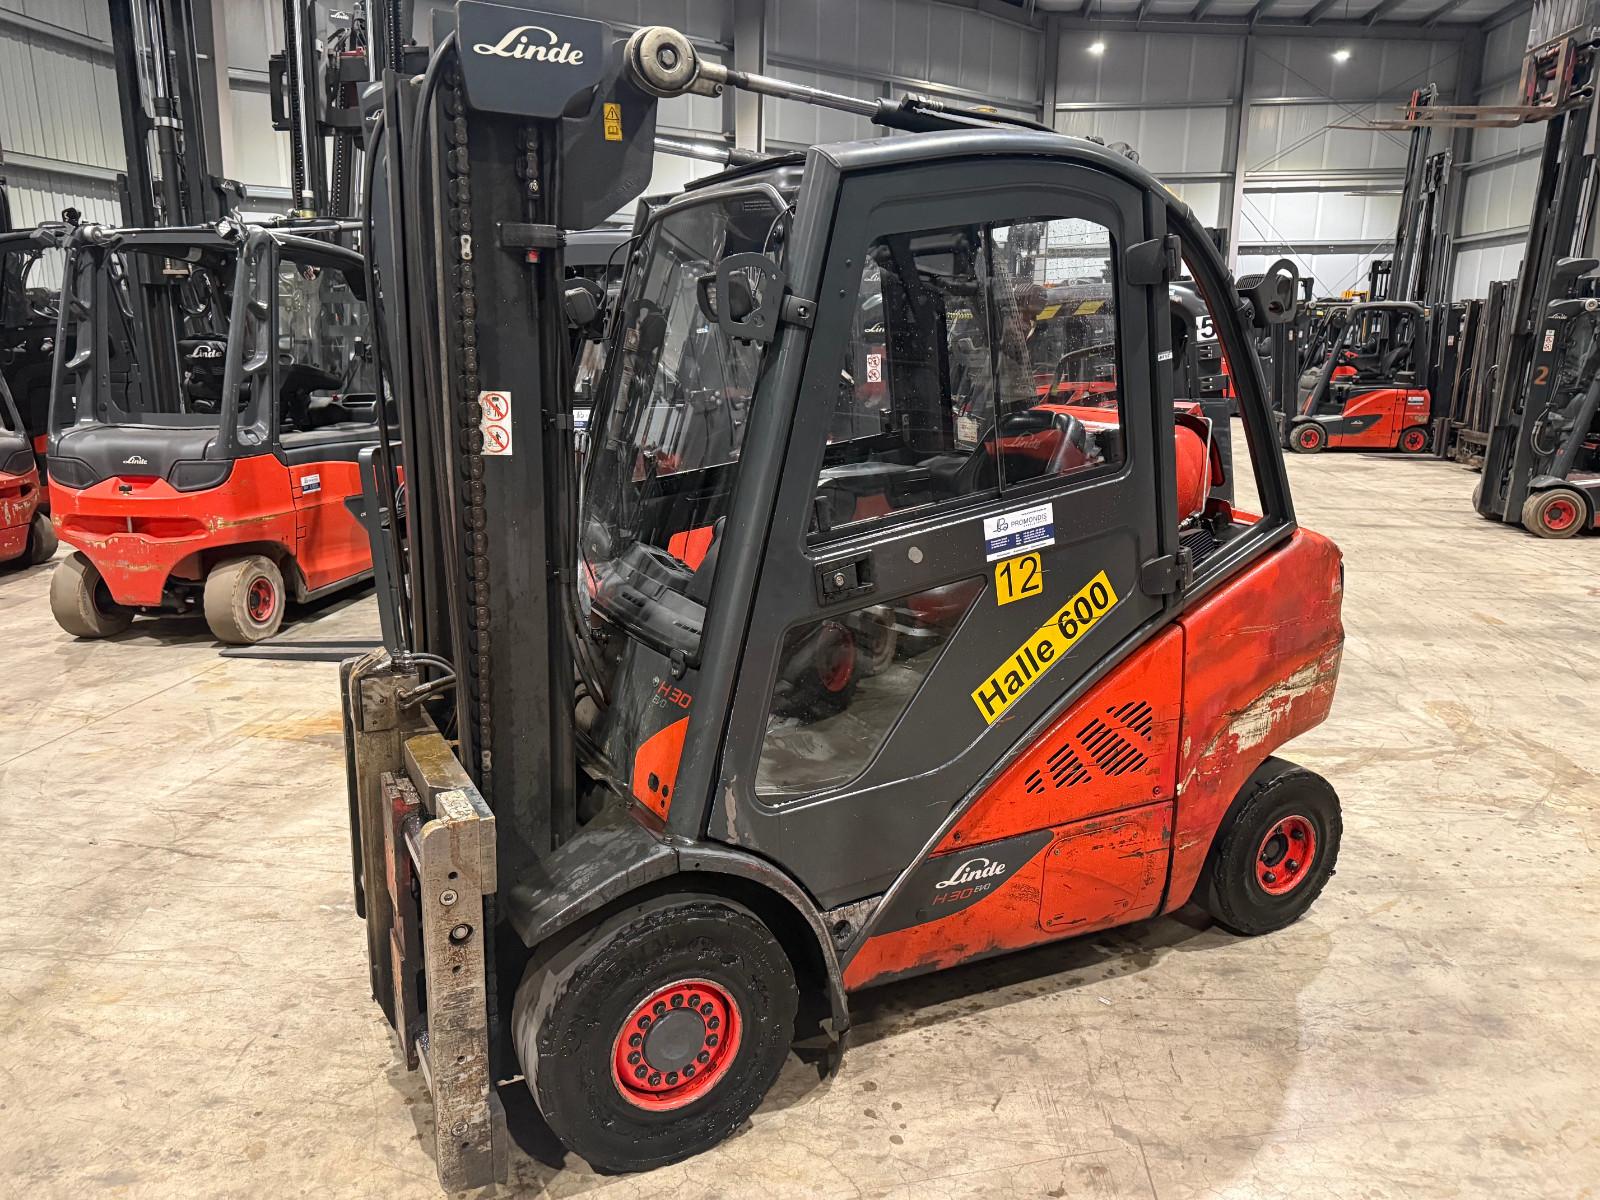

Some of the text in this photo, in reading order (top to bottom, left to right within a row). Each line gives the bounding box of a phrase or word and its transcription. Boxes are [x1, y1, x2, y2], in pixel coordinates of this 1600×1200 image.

[472, 25, 584, 65] Linde
[864, 322, 885, 333] Lin
[184, 345, 223, 359] Linde
[1534, 366, 1550, 385] 2
[1003, 430, 1041, 450] Linde
[1010, 512, 1048, 528] PROMONDIS
[1000, 556, 1040, 598] 12
[978, 581, 1109, 717] Halle 600
[656, 680, 693, 709] H30
[935, 857, 1006, 889] Linde
[932, 882, 991, 906] H30 EVO
